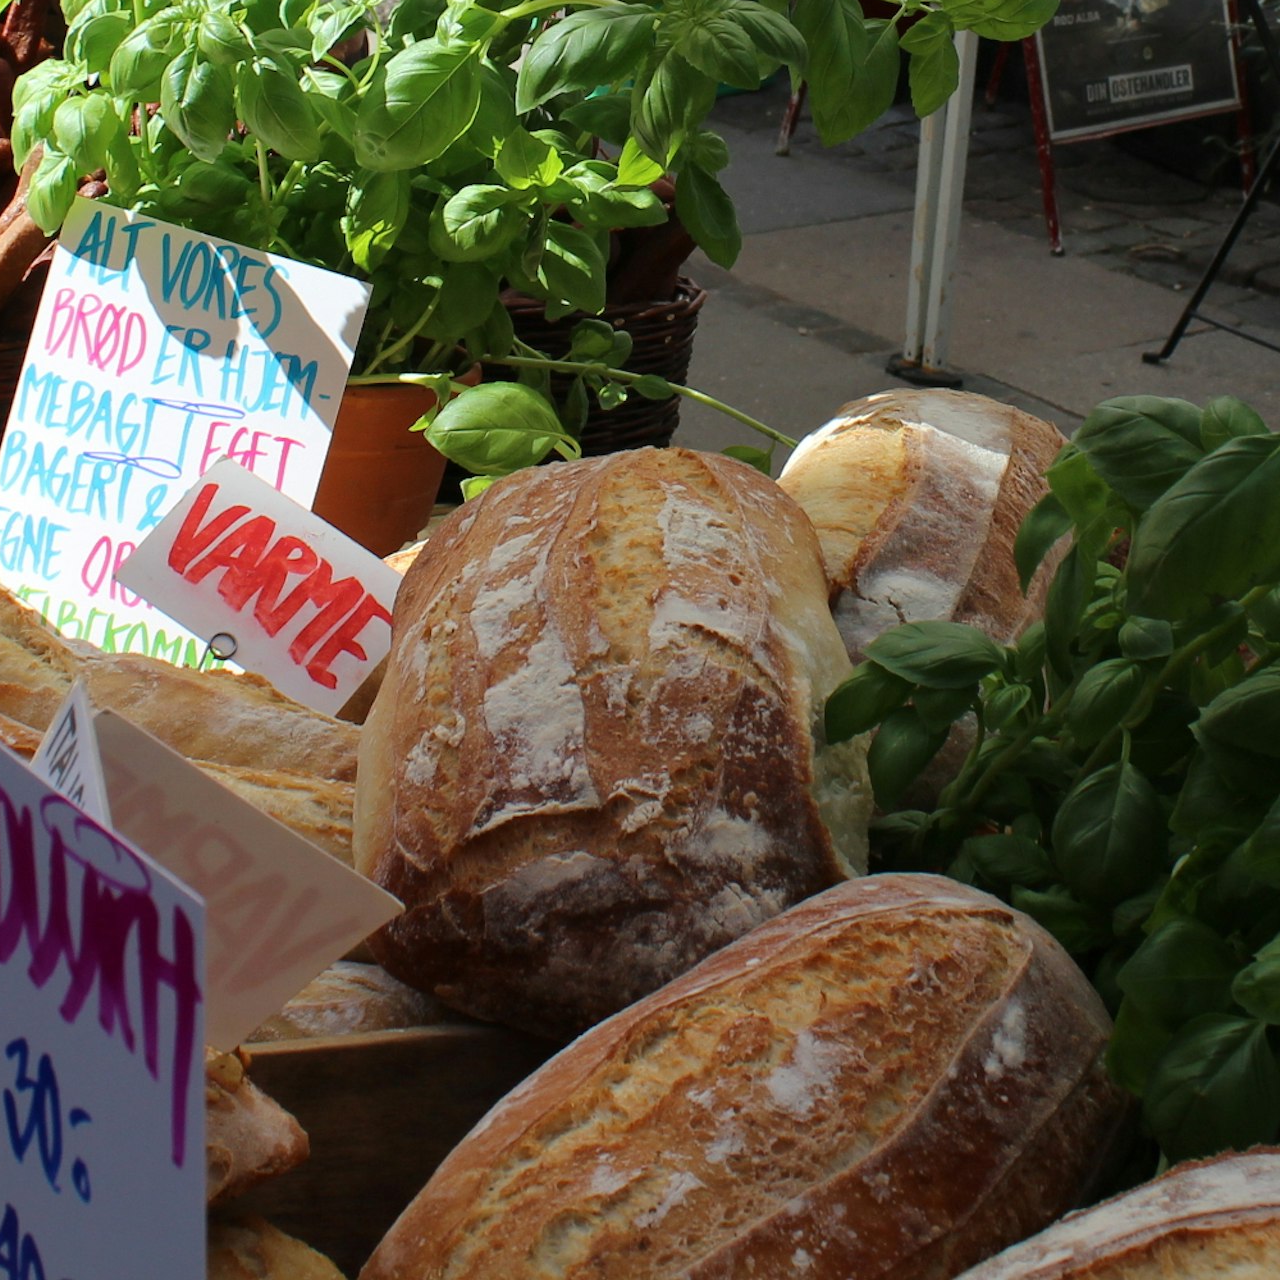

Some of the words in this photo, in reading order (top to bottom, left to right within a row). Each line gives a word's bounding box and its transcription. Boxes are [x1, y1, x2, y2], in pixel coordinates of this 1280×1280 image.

[1086, 82, 1108, 103] DIN
[1111, 68, 1191, 99] OSTEHANDLER
[64, 211, 157, 293] ALT
[161, 233, 291, 341] VORES
[43, 288, 148, 378] BRØD
[151, 325, 212, 399] ER
[167, 483, 394, 690] VARME
